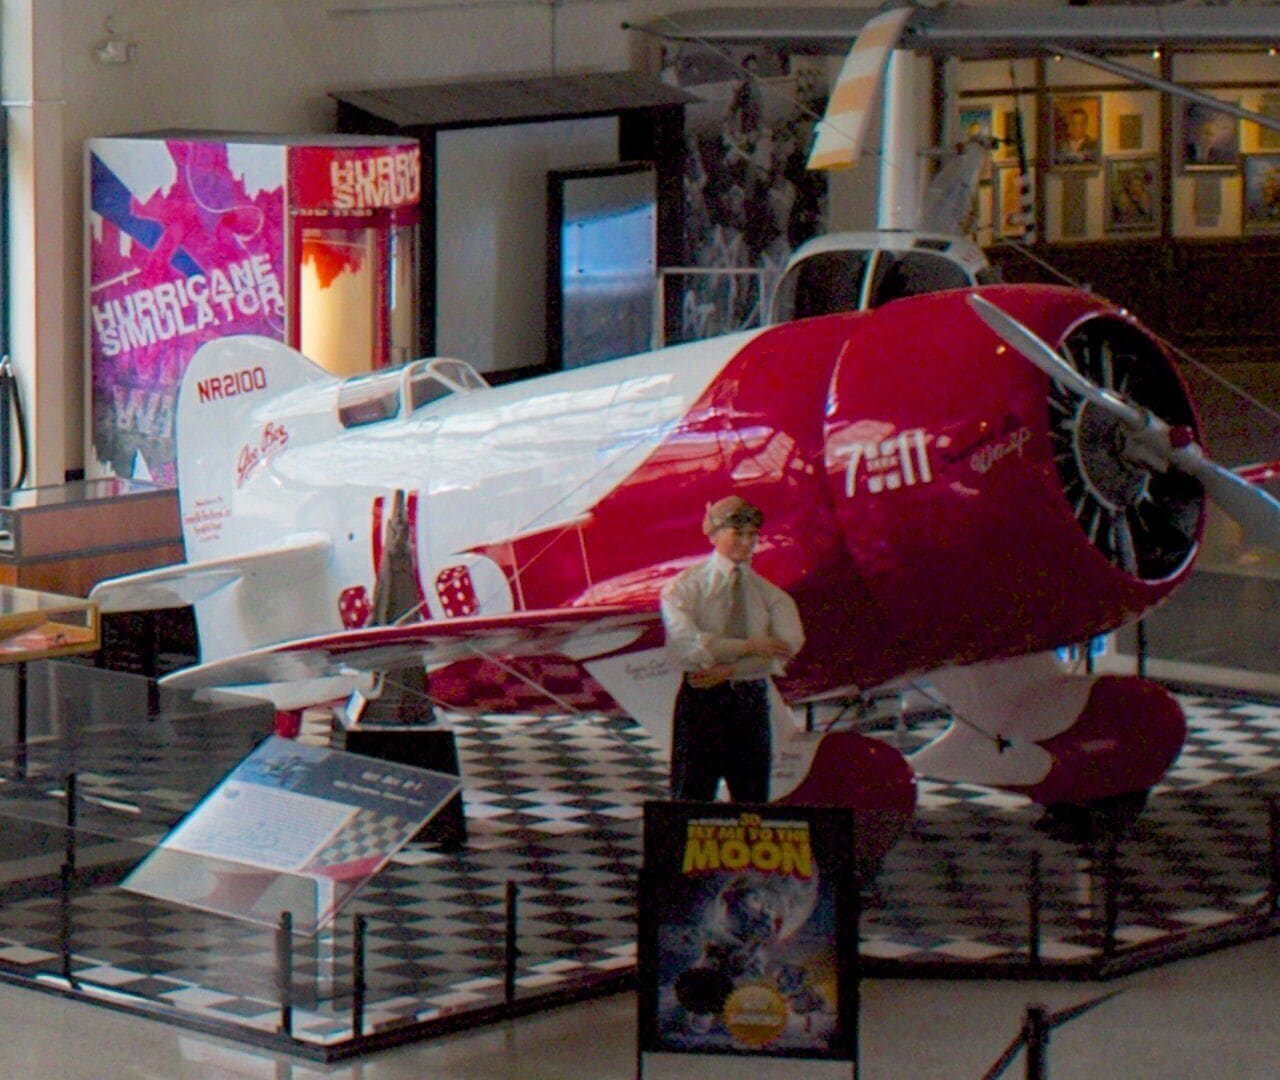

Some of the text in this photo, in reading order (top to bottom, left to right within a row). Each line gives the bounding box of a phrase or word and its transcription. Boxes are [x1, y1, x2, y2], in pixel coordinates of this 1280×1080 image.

[92, 253, 273, 333] HURRICANE
[100, 272, 285, 356] SIMULATOR
[197, 366, 268, 403] NR2100
[682, 839, 812, 877] MOON
